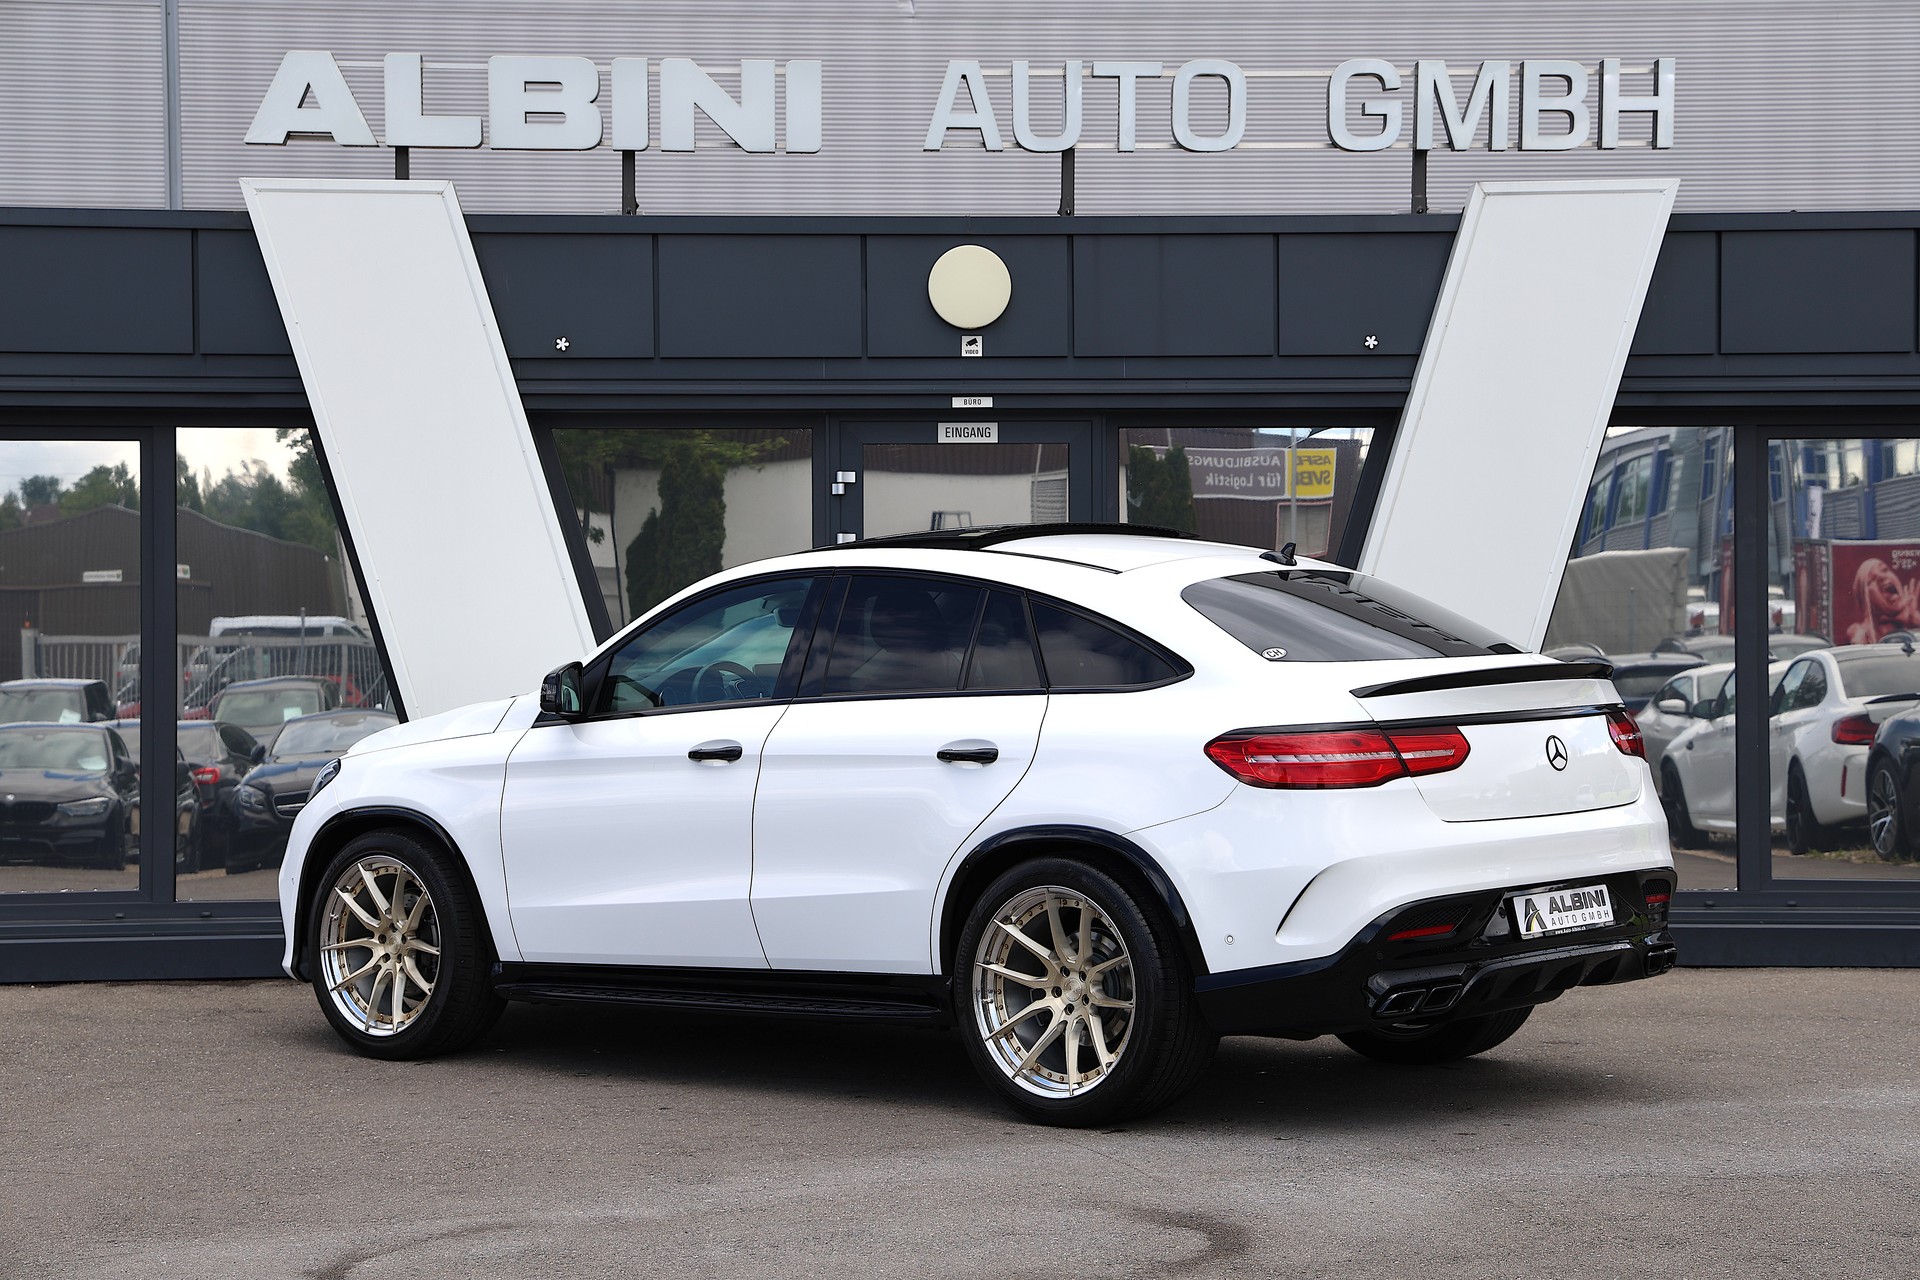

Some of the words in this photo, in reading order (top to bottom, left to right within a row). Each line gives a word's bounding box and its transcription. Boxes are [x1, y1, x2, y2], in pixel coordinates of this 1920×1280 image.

[243, 50, 823, 154] ALBINI
[923, 58, 1248, 153] AUTO
[1326, 57, 1677, 153] GMBH
[963, 398, 982, 406] BÜRO
[945, 426, 991, 438] EINGANG
[1266, 648, 1283, 658] CH
[1548, 889, 1607, 915] ALBINI
[1551, 912, 1578, 927] AUTO
[1581, 909, 1610, 922] GMBH
